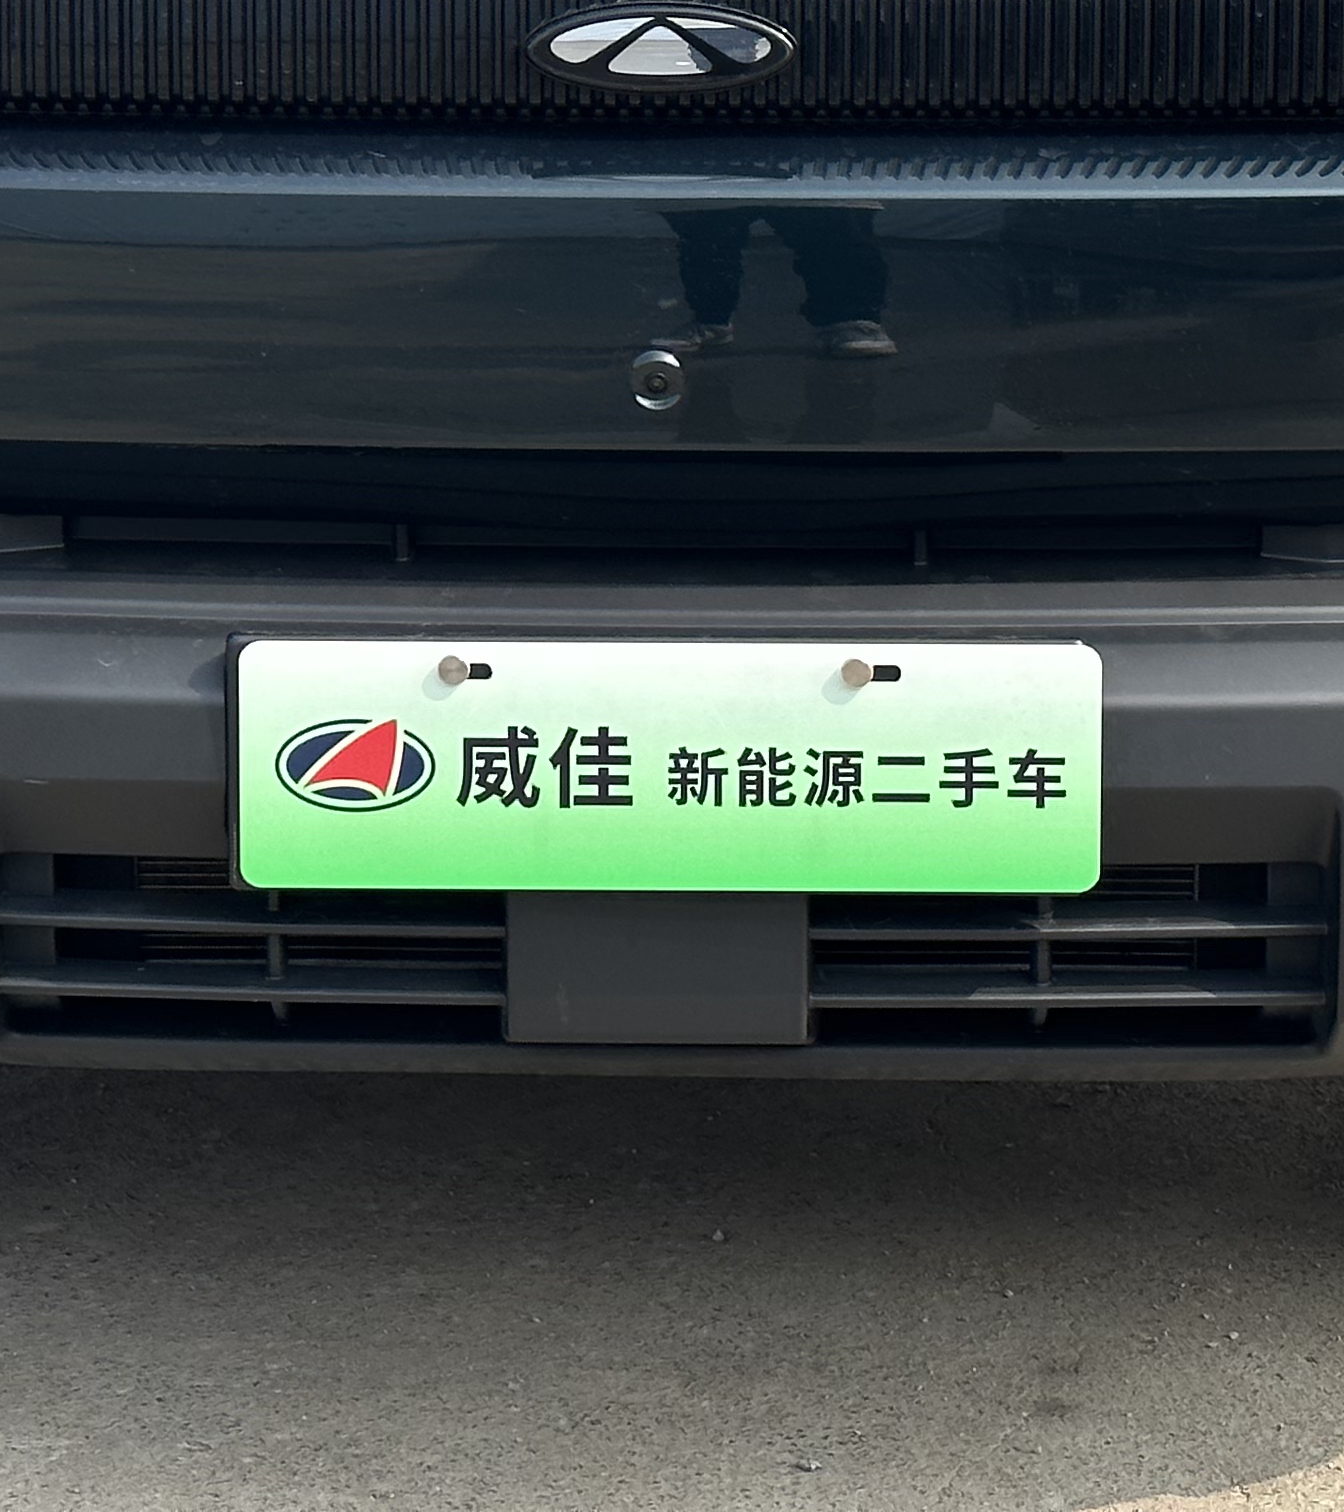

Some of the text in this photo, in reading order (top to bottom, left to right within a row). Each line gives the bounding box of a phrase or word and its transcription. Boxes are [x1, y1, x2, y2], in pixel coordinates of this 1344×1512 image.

[455, 726, 1069, 810] 威佳 新能源二手车
